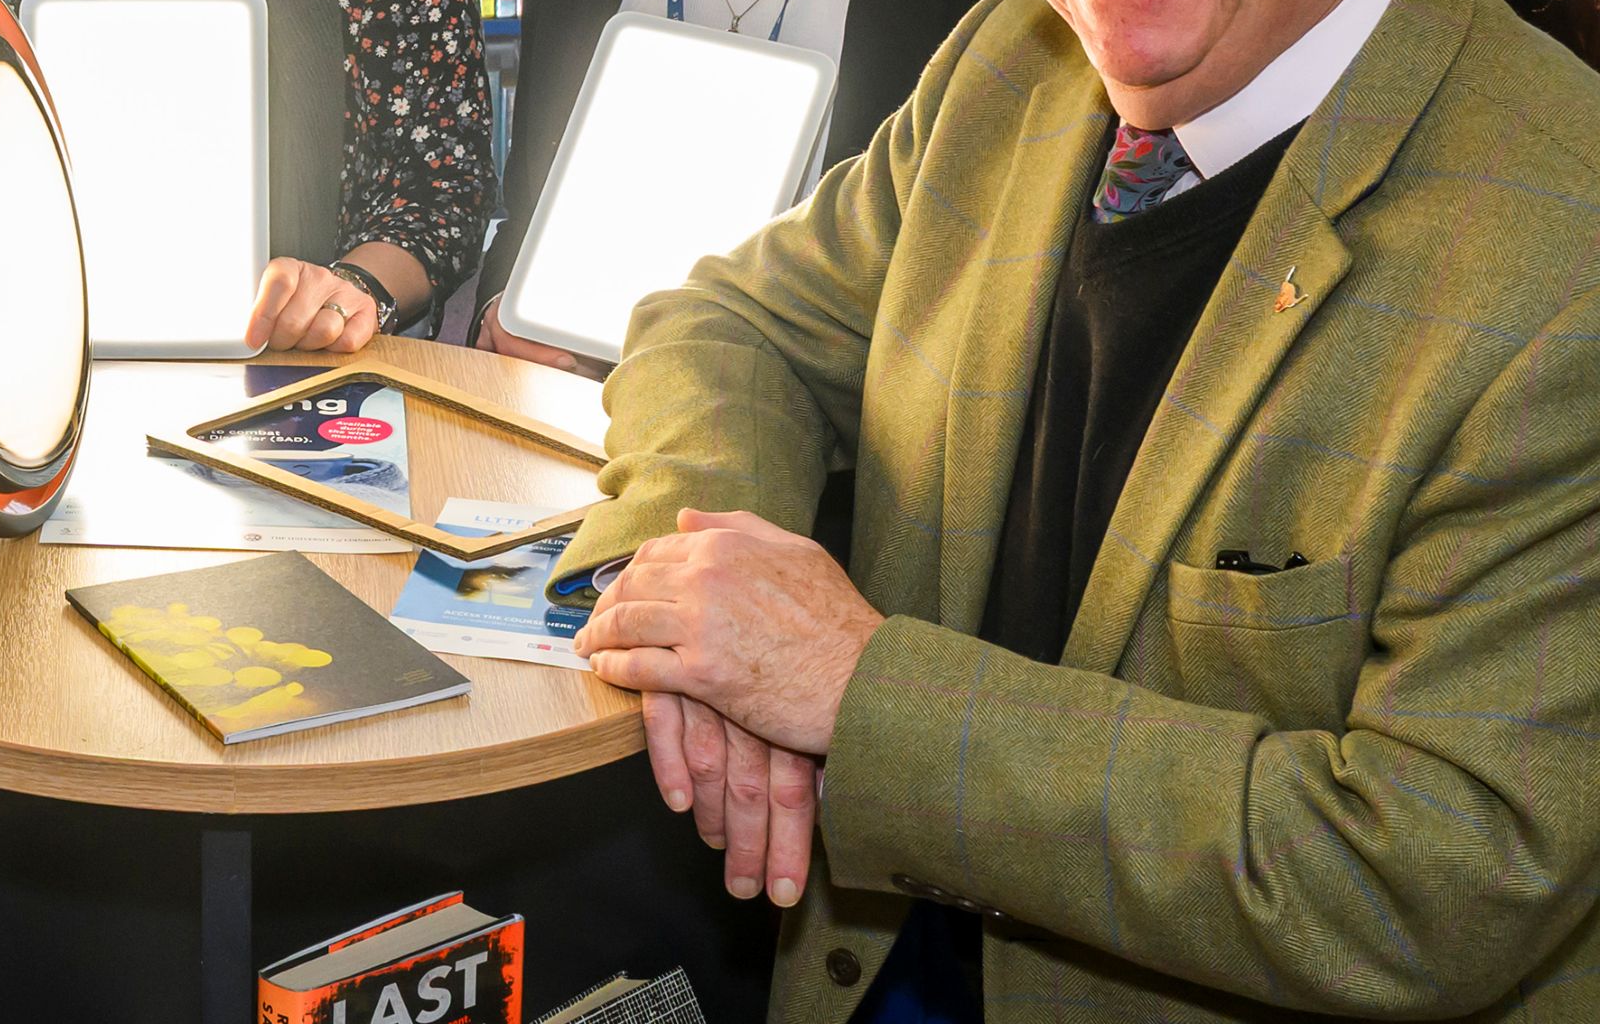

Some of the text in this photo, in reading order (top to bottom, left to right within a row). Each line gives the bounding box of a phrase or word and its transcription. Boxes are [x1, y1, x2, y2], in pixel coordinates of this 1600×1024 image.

[229, 428, 281, 437] combat
[269, 436, 313, 444] (SAD).
[443, 608, 482, 619] ACCESS
[483, 613, 502, 621] THE
[503, 615, 546, 626] COURSE
[546, 622, 576, 630] HERE:
[333, 951, 488, 1024] LAST
